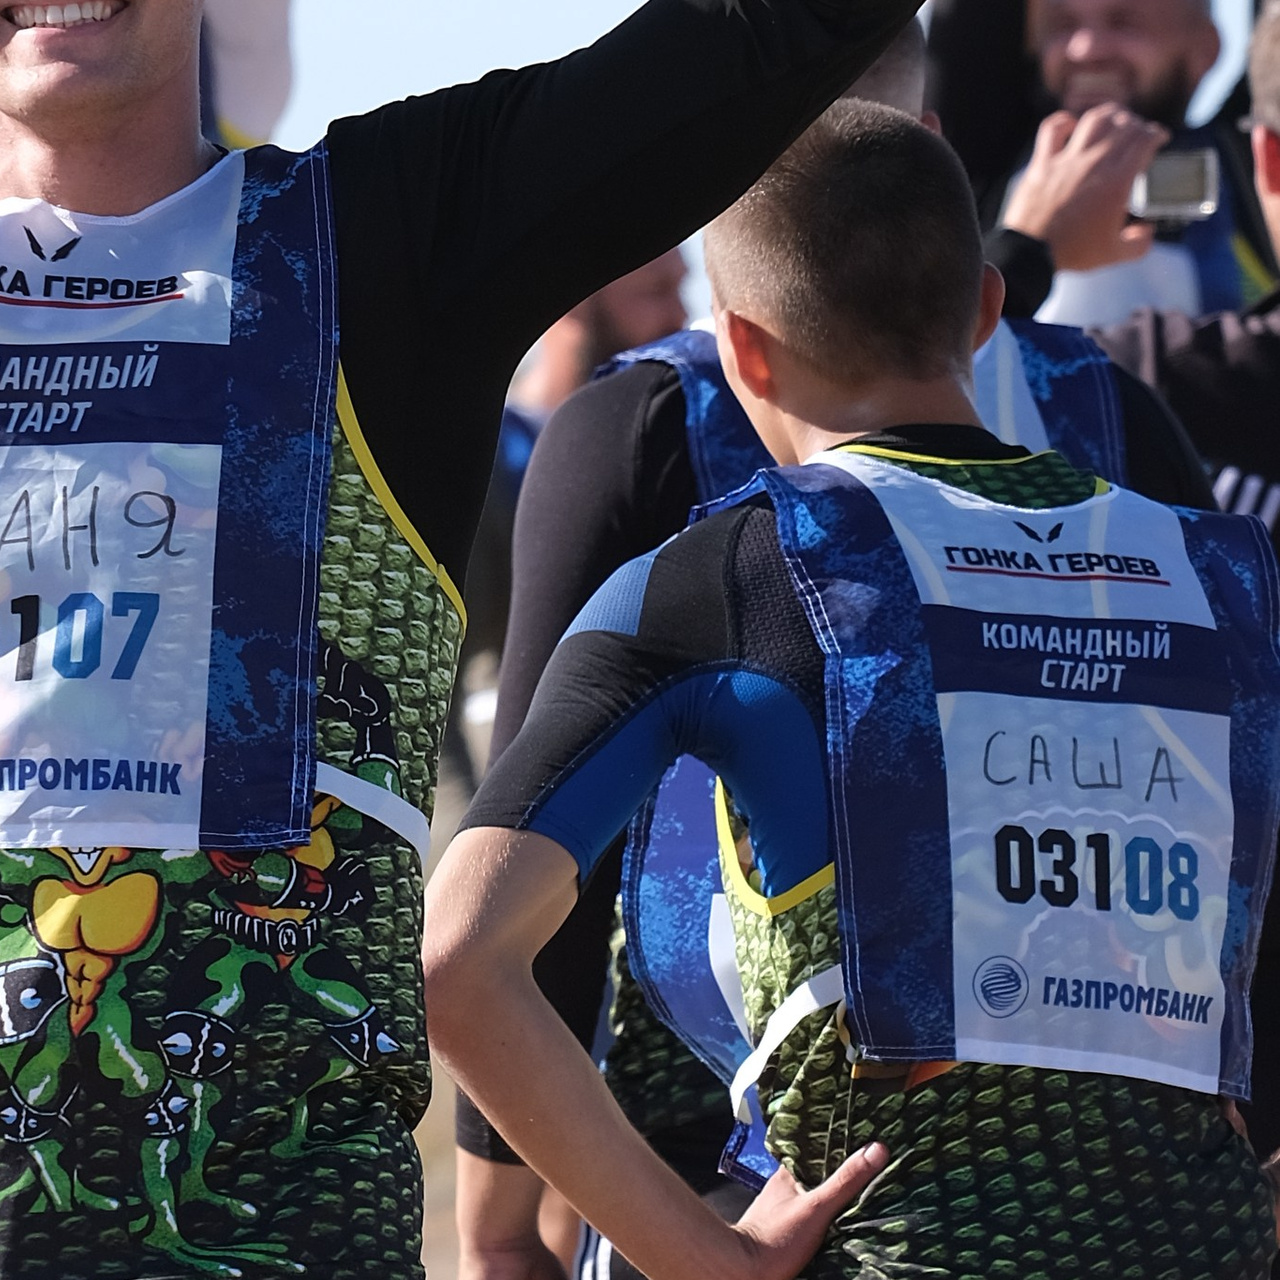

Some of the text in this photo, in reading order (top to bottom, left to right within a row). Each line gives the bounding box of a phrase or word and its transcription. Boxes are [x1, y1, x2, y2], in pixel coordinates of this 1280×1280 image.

[43, 275, 179, 301] ГЕРОЕВ
[943, 546, 1162, 578] ГОНКА ГЕРОЕВ
[982, 622, 1171, 661] КОМАНДНЫЙ
[1040, 658, 1127, 694] СТАРТ
[982, 730, 1185, 803] САША
[993, 824, 1201, 922] 03108
[1042, 975, 1215, 1025] ГАЗПРОМБАНК
